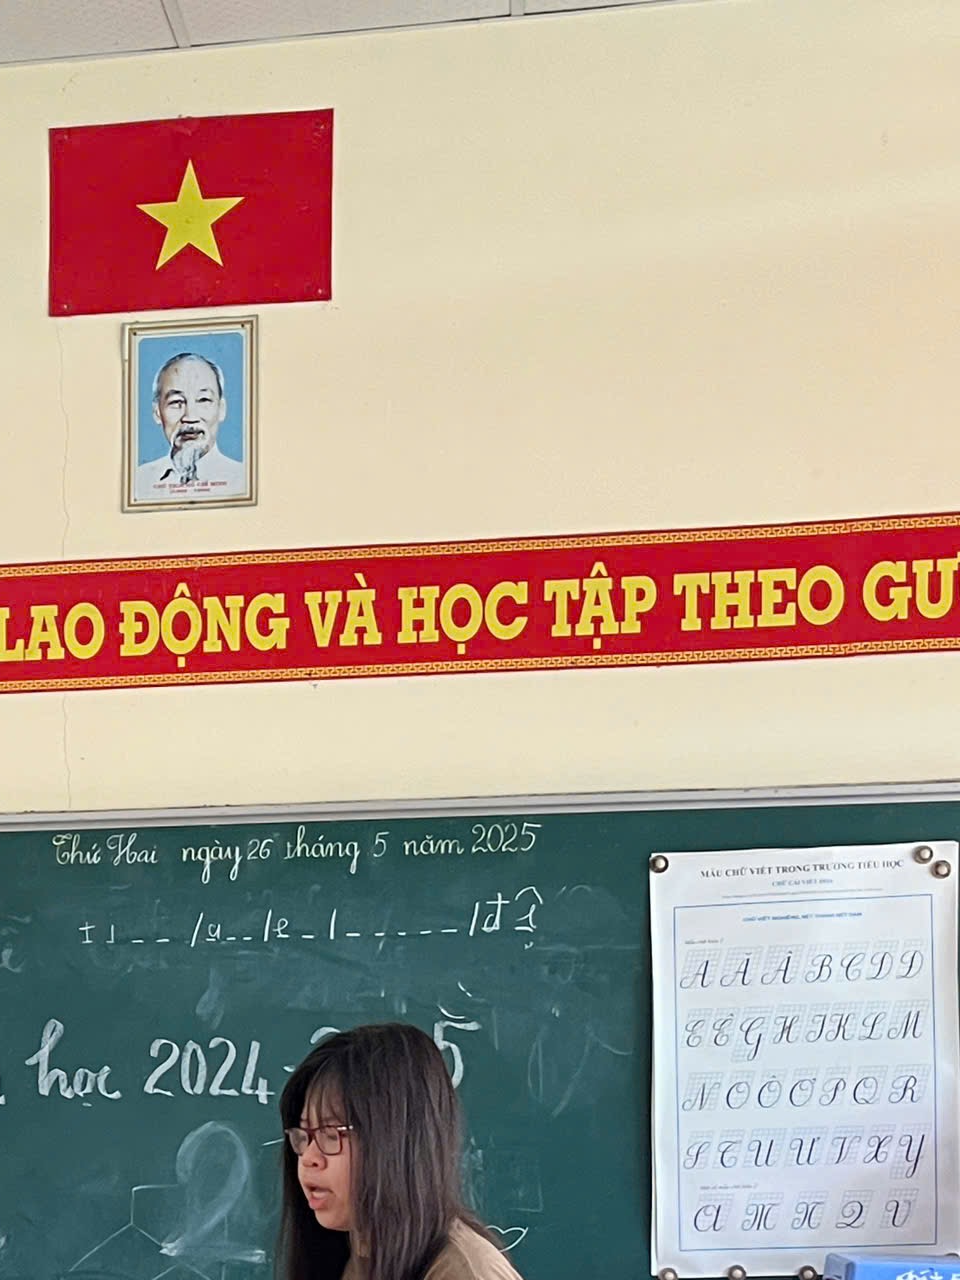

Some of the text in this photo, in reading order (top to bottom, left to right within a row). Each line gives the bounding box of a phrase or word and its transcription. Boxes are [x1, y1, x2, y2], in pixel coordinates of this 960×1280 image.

[118, 582, 291, 668] ĐỘNG
[305, 573, 382, 648] VÀ
[398, 581, 528, 655] HỌC
[544, 562, 657, 649] TẬP
[674, 565, 845, 631] THEO
[106, 833, 159, 866] Hai
[181, 840, 244, 884] ngày
[247, 838, 274, 860] 26
[284, 825, 360, 874] tháng
[373, 831, 390, 857] 5
[404, 835, 465, 856] năm
[471, 823, 542, 853] 2025
[680, 959, 712, 989] A
[720, 952, 753, 987] Ă
[805, 953, 833, 983] B
[840, 952, 866, 982] C
[685, 1019, 705, 1048] E
[712, 1013, 734, 1046] Ê
[740, 1016, 765, 1060] G
[772, 1015, 800, 1044] H
[828, 1013, 856, 1041] K
[859, 1011, 886, 1041] L
[888, 1010, 923, 1040] M
[25, 1018, 122, 1107] học
[143, 1037, 276, 1105] 2024
[682, 1081, 721, 1111] N
[726, 1081, 750, 1110] O
[757, 1075, 782, 1109] Ô
[819, 1077, 846, 1106] P
[852, 1076, 878, 1104] Q
[888, 1075, 920, 1103] R
[683, 1141, 711, 1170] S
[717, 1139, 742, 1168] T
[748, 1139, 776, 1167] U
[831, 1135, 862, 1164] V
[863, 1135, 893, 1163] X
[898, 1134, 925, 1178] Y
